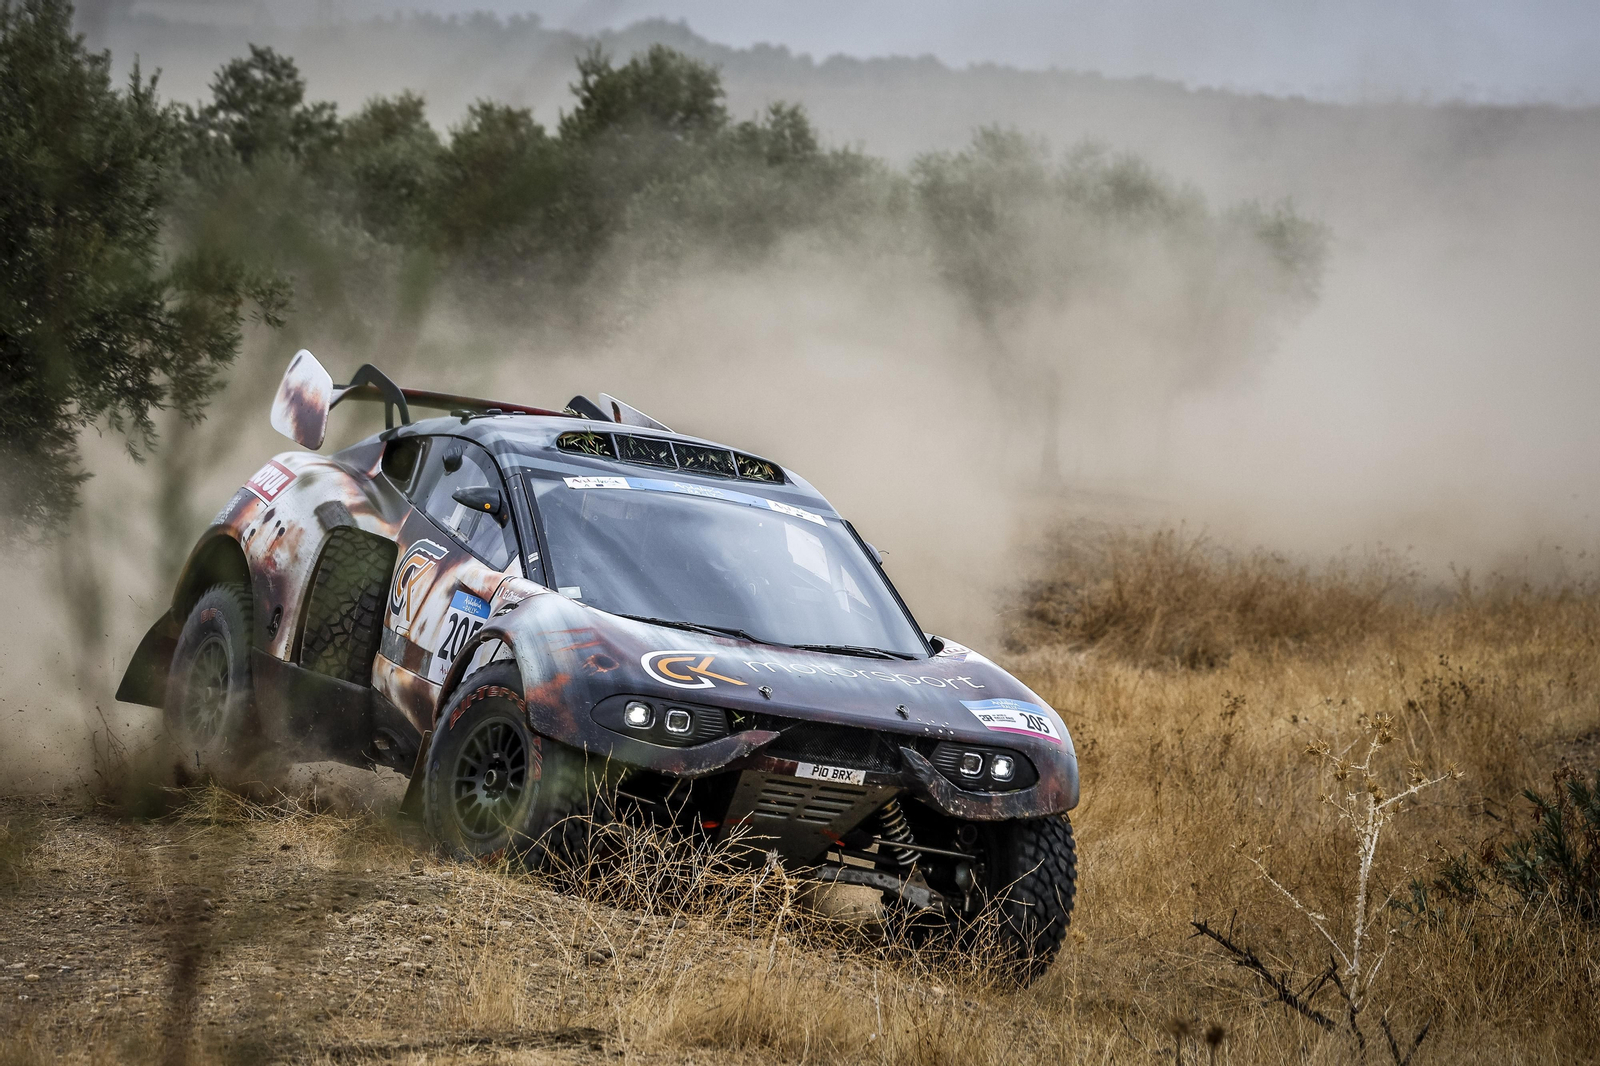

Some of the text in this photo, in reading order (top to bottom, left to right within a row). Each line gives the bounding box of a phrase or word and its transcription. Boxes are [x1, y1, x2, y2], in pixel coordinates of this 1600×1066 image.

[743, 660, 985, 691] motorsport
[450, 684, 526, 731] All-Terra
[1019, 713, 1050, 734] 205
[811, 766, 853, 781] P10 BRX
